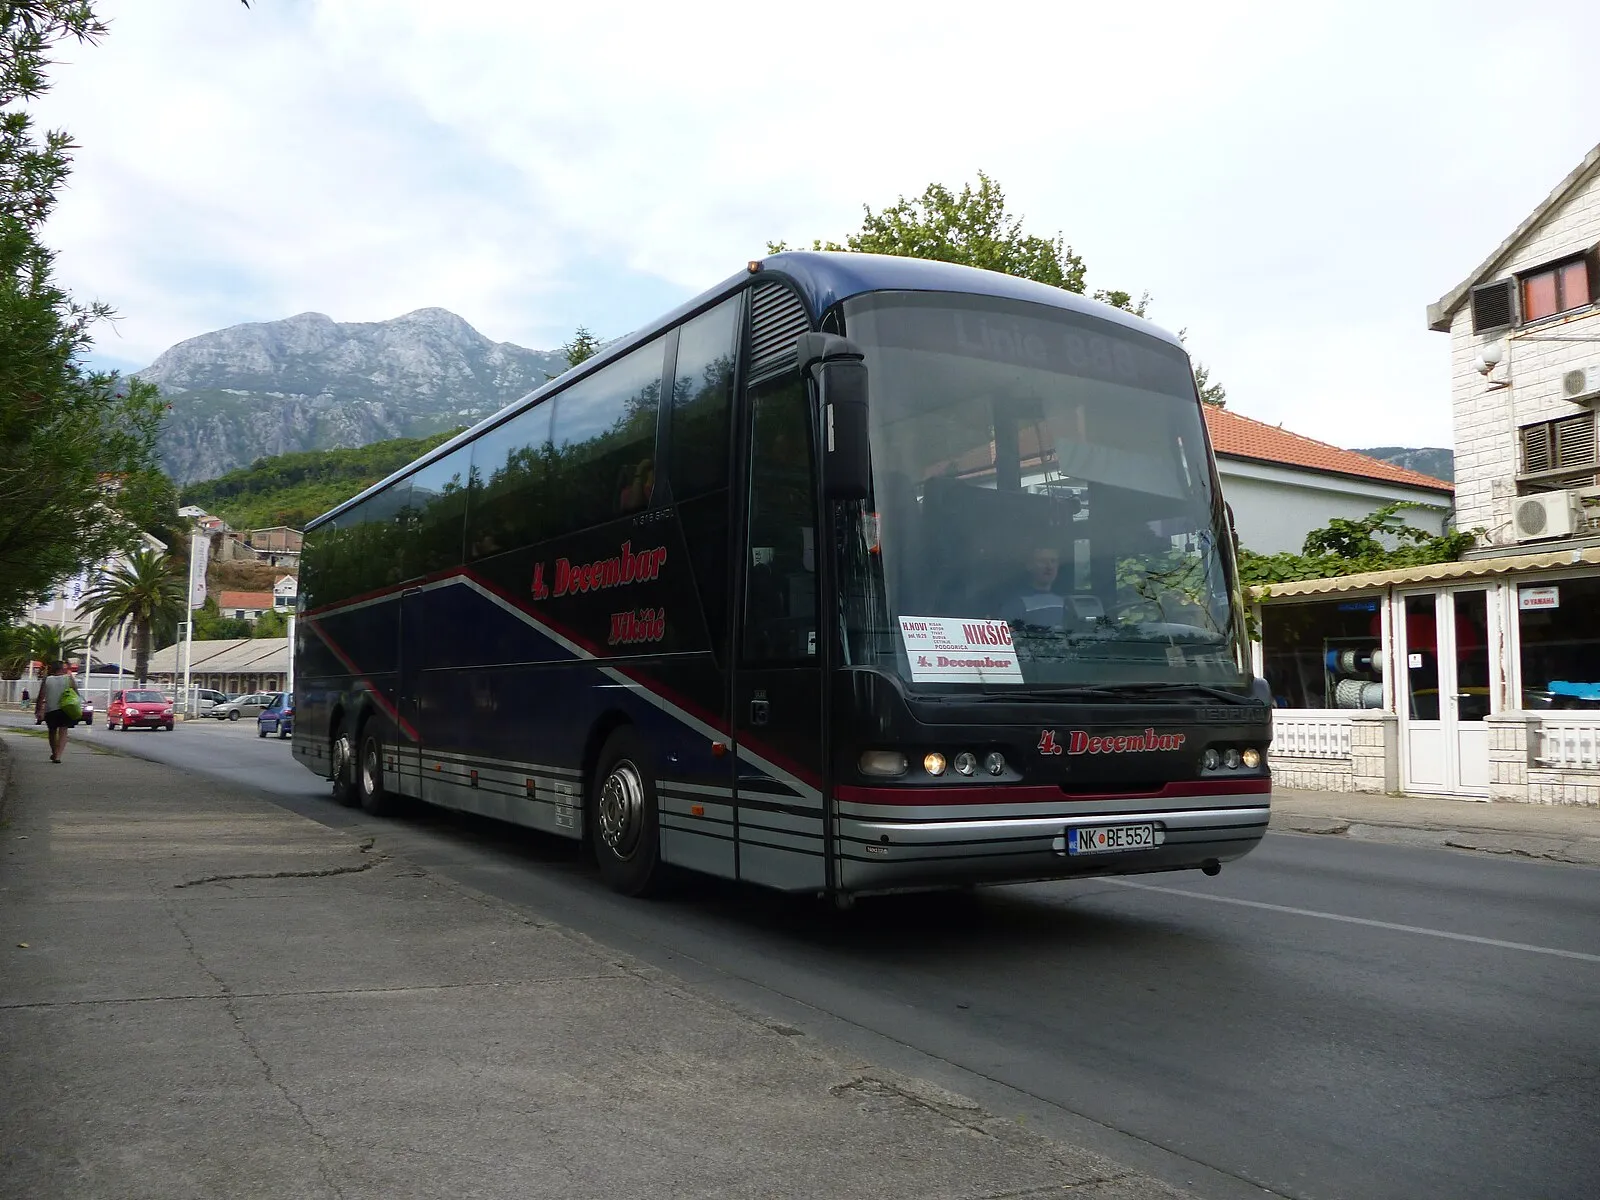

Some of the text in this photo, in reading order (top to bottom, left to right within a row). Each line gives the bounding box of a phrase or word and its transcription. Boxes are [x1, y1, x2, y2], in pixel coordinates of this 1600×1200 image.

[531, 540, 667, 600] 4. Decembar
[1530, 597, 1555, 606] YAMAHA
[608, 607, 665, 645] Nikšić
[962, 621, 1012, 646] NIKŠIĆ
[917, 656, 1011, 668] 4. Decembar
[1038, 728, 1185, 755] 4. Decembar
[1080, 830, 1096, 849] NK
